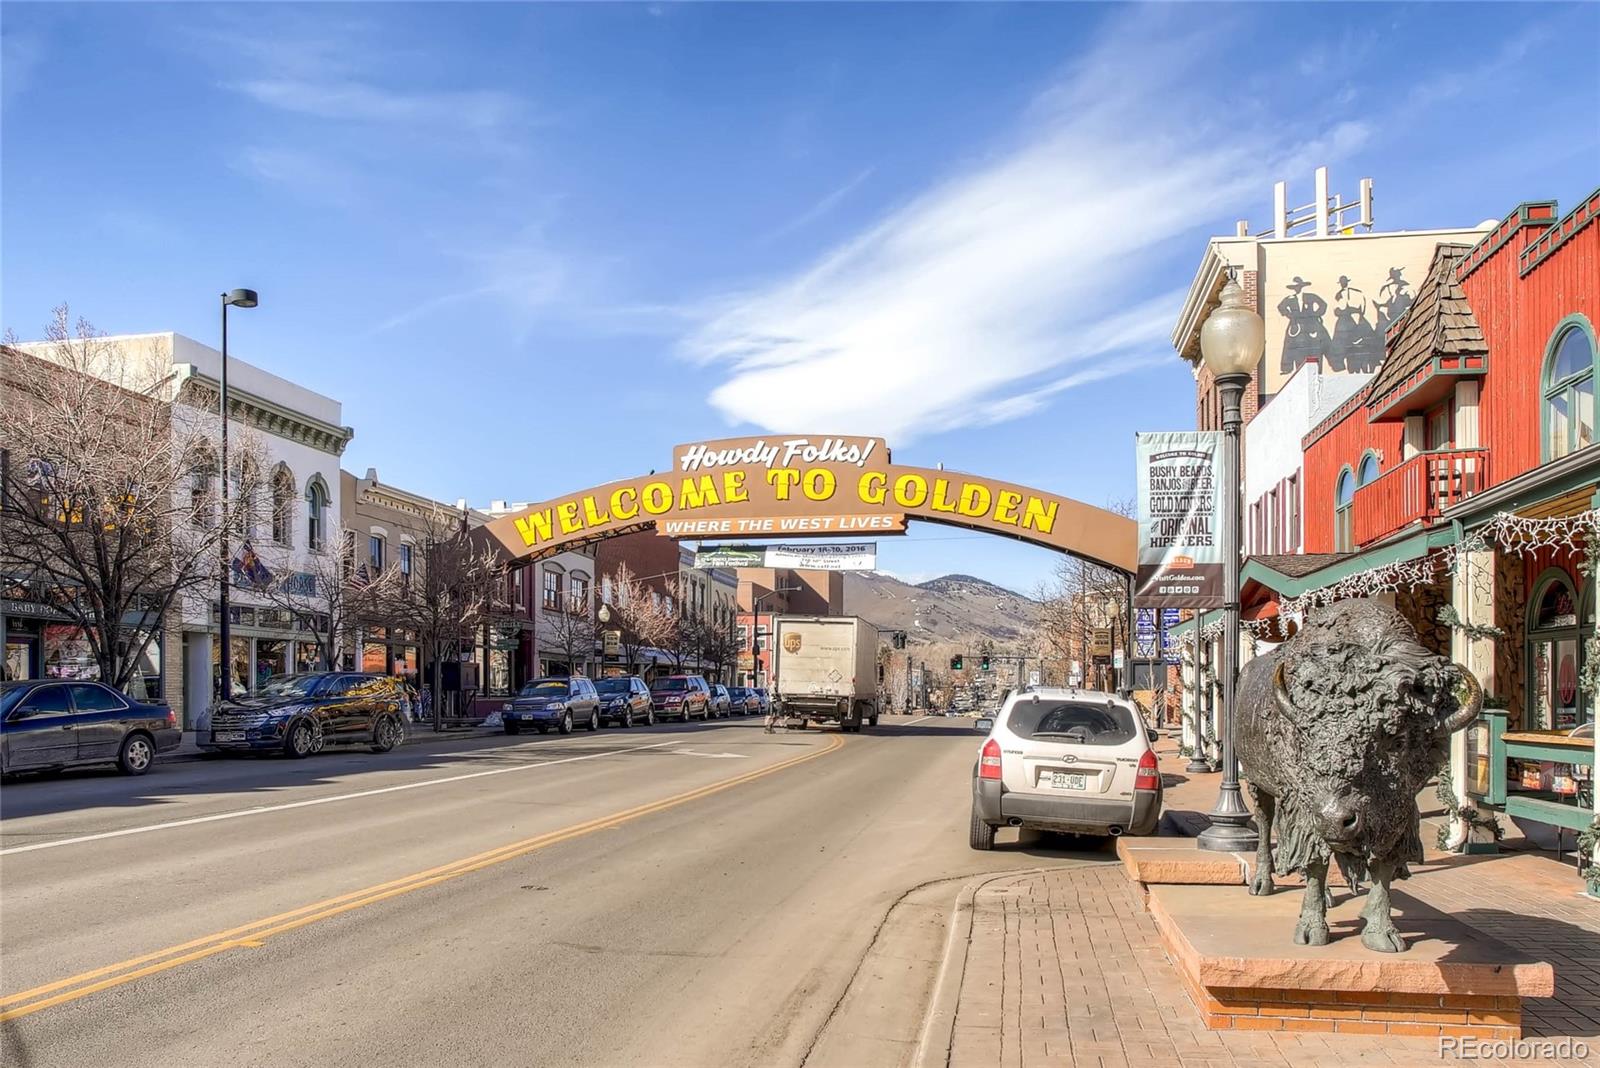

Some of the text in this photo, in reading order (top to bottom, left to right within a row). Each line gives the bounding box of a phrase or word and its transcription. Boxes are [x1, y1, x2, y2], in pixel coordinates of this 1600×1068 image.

[681, 438, 876, 471] Howdy Folks!
[1149, 465, 1215, 478] BUSHY BEARDS.
[1149, 478, 1182, 491] BANJOS
[514, 468, 1061, 547] WELCOME TO GOLDEN
[1149, 496, 1174, 513] GOLD
[665, 516, 893, 534] WHERE THE WEST LIVES
[1160, 516, 1213, 537] ORIGNAL
[777, 545, 816, 553] February
[846, 545, 866, 553] 2016
[11, 602, 36, 613] BABY
[785, 639, 800, 651] ups
